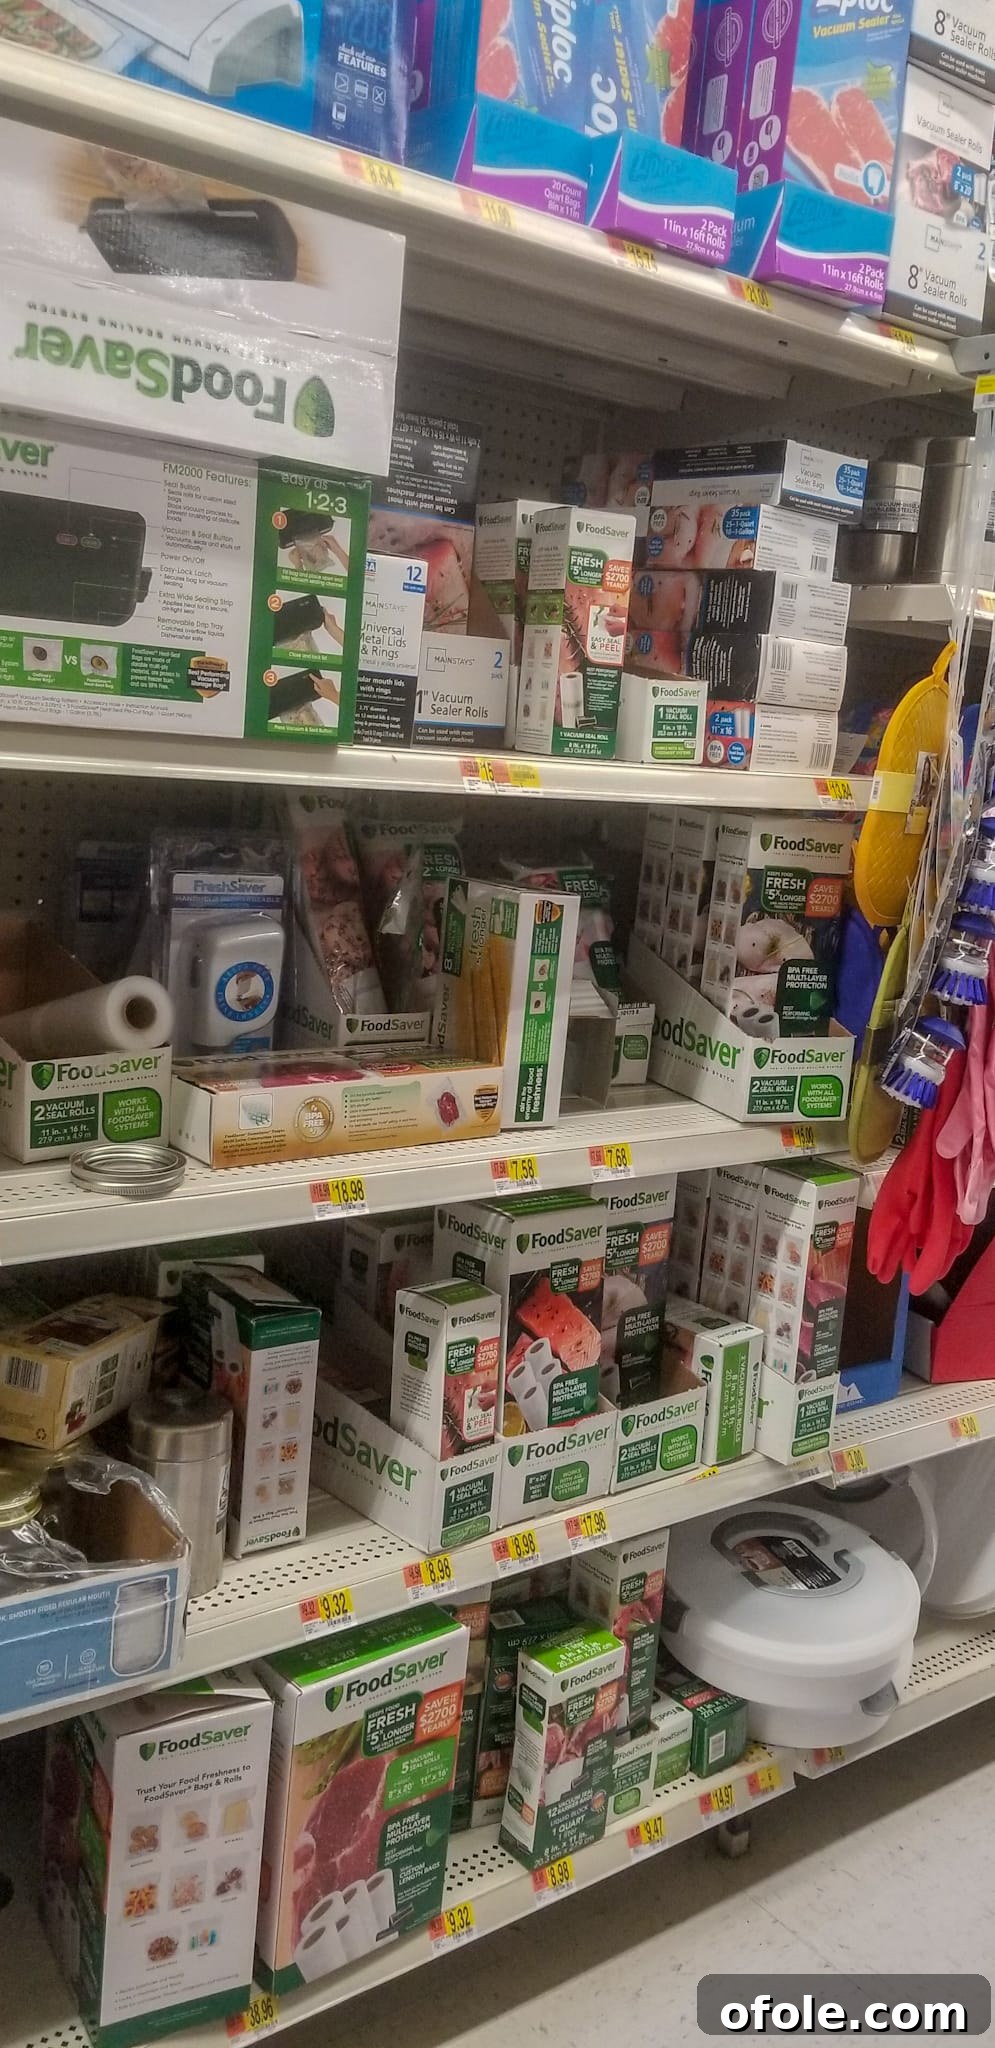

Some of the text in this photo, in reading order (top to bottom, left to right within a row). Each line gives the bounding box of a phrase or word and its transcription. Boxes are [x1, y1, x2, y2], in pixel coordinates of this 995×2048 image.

[812, 14, 889, 38] Vacuum Sealer
[952, 16, 987, 41] Vacuum
[337, 52, 387, 78] FEATURES
[917, 114, 983, 155] Vacuum Sealer Rolls
[552, 179, 582, 199] 20 Count
[544, 187, 581, 210] Quart Bags
[663, 217, 726, 249] 11in x 16ft Rolls
[701, 218, 727, 238] 2 Pack
[822, 263, 884, 291] 11in x 16ft Rolls
[859, 263, 885, 279] 2 Pack
[924, 270, 957, 289] Vacuum
[922, 282, 968, 308] Sealer Rolls
[14, 321, 288, 425] FoodSaver
[163, 462, 251, 489] FM2000 Features:
[281, 470, 329, 494] easy as
[585, 522, 630, 539] FoodSaver
[160, 551, 181, 561] Power
[570, 555, 604, 570] FRESH
[406, 565, 422, 582] 12
[608, 563, 624, 574] SAVE
[605, 572, 630, 583] $2700
[365, 599, 406, 614] MAINSTAYS
[387, 635, 407, 648] Lids
[590, 636, 621, 645] EASY SEAL
[590, 641, 620, 652] & PEEL
[63, 654, 78, 666] VS
[360, 645, 399, 661] & Rings
[434, 655, 475, 666] MAINSTAYS
[493, 651, 503, 669] 2
[431, 690, 473, 705] Vacuum
[660, 687, 701, 697] FoodSaver
[430, 703, 489, 719] Sealer Rolls
[774, 835, 844, 854] FoodSaver
[193, 879, 267, 894] FreshSaver
[765, 877, 807, 890] FRESH
[813, 884, 835, 893] SAVE
[809, 893, 839, 905] $2700
[787, 966, 818, 974] BPA FREE
[785, 981, 828, 990] PROTECTION
[360, 1018, 425, 1032] FoodSaver
[770, 1049, 846, 1064] FoodSaver
[531, 1065, 544, 1113] freshness.
[751, 1080, 788, 1093] 2 VACUUM
[33, 1100, 85, 1121] 2 VACUUM
[118, 1096, 148, 1108] WORKS
[46, 1106, 96, 1121] SEAL ROLLS
[108, 1111, 154, 1125] FOODSAVER
[114, 1105, 151, 1117] WITH ALL
[305, 1111, 323, 1120] BPA
[114, 1121, 150, 1132] SYSTEMS
[303, 1118, 325, 1128] FREE
[609, 1190, 670, 1211] FoodSaver
[770, 1188, 811, 1210] FoodSaver
[823, 1194, 857, 1209] FoodSaver
[447, 1213, 507, 1250] FoodSaver
[531, 1224, 604, 1249] FoodSaver
[645, 1231, 662, 1242] SAVE
[616, 1248, 640, 1259] LONGER
[551, 1265, 579, 1279] FRESH
[405, 1307, 441, 1327] FoodSaver
[458, 1310, 497, 1326] FoodSaver
[624, 1323, 660, 1338] PROTECTION
[448, 1345, 476, 1359] FRESH
[552, 1389, 588, 1404] PROTECTION
[804, 1383, 836, 1397] FoodSaver
[636, 1399, 700, 1429] FoodSaver
[526, 1425, 612, 1461] FoodSaver
[620, 1440, 651, 1460] 2 VACUUM
[450, 1454, 499, 1477] FoodSaver
[449, 1479, 484, 1503] 1 VACUUM
[455, 1486, 488, 1501] SEAL ROLL
[245, 1529, 292, 1548] FoodSaver
[629, 1541, 666, 1561] FoodSaver
[621, 1577, 645, 1593] FRESH
[8, 1607, 37, 1622] SMOOTH
[57, 1598, 87, 1611] REGULAR
[87, 1591, 111, 1602] MOUTH
[346, 1650, 448, 1702] FoodSaver
[570, 1661, 616, 1688] FoodSaver
[424, 1695, 450, 1713] SAVE
[568, 1695, 596, 1711] FRESH
[367, 1703, 417, 1734] FRESH
[419, 1704, 457, 1728] $2700
[158, 1724, 251, 1755] FoodSaver
[383, 1721, 415, 1742] LONGER
[401, 1751, 434, 1774] 5 VACUUM
[409, 1755, 441, 1771] SEAL ROLLS
[136, 1785, 157, 1796] Trust
[158, 1781, 178, 1792] Your
[178, 1774, 200, 1787] Food
[201, 1765, 240, 1781] Freshness
[387, 1811, 421, 1833] BPA FREE
[550, 1805, 589, 1828] LIQUID BLOCK
[386, 1815, 432, 1841] MULTI-LAYER
[552, 1815, 586, 1836] 1 QUART
[385, 1823, 431, 1848] PROTECTION
[398, 1861, 441, 1886] LENGTH BAGS
[399, 1862, 426, 1879] CUSTOM
